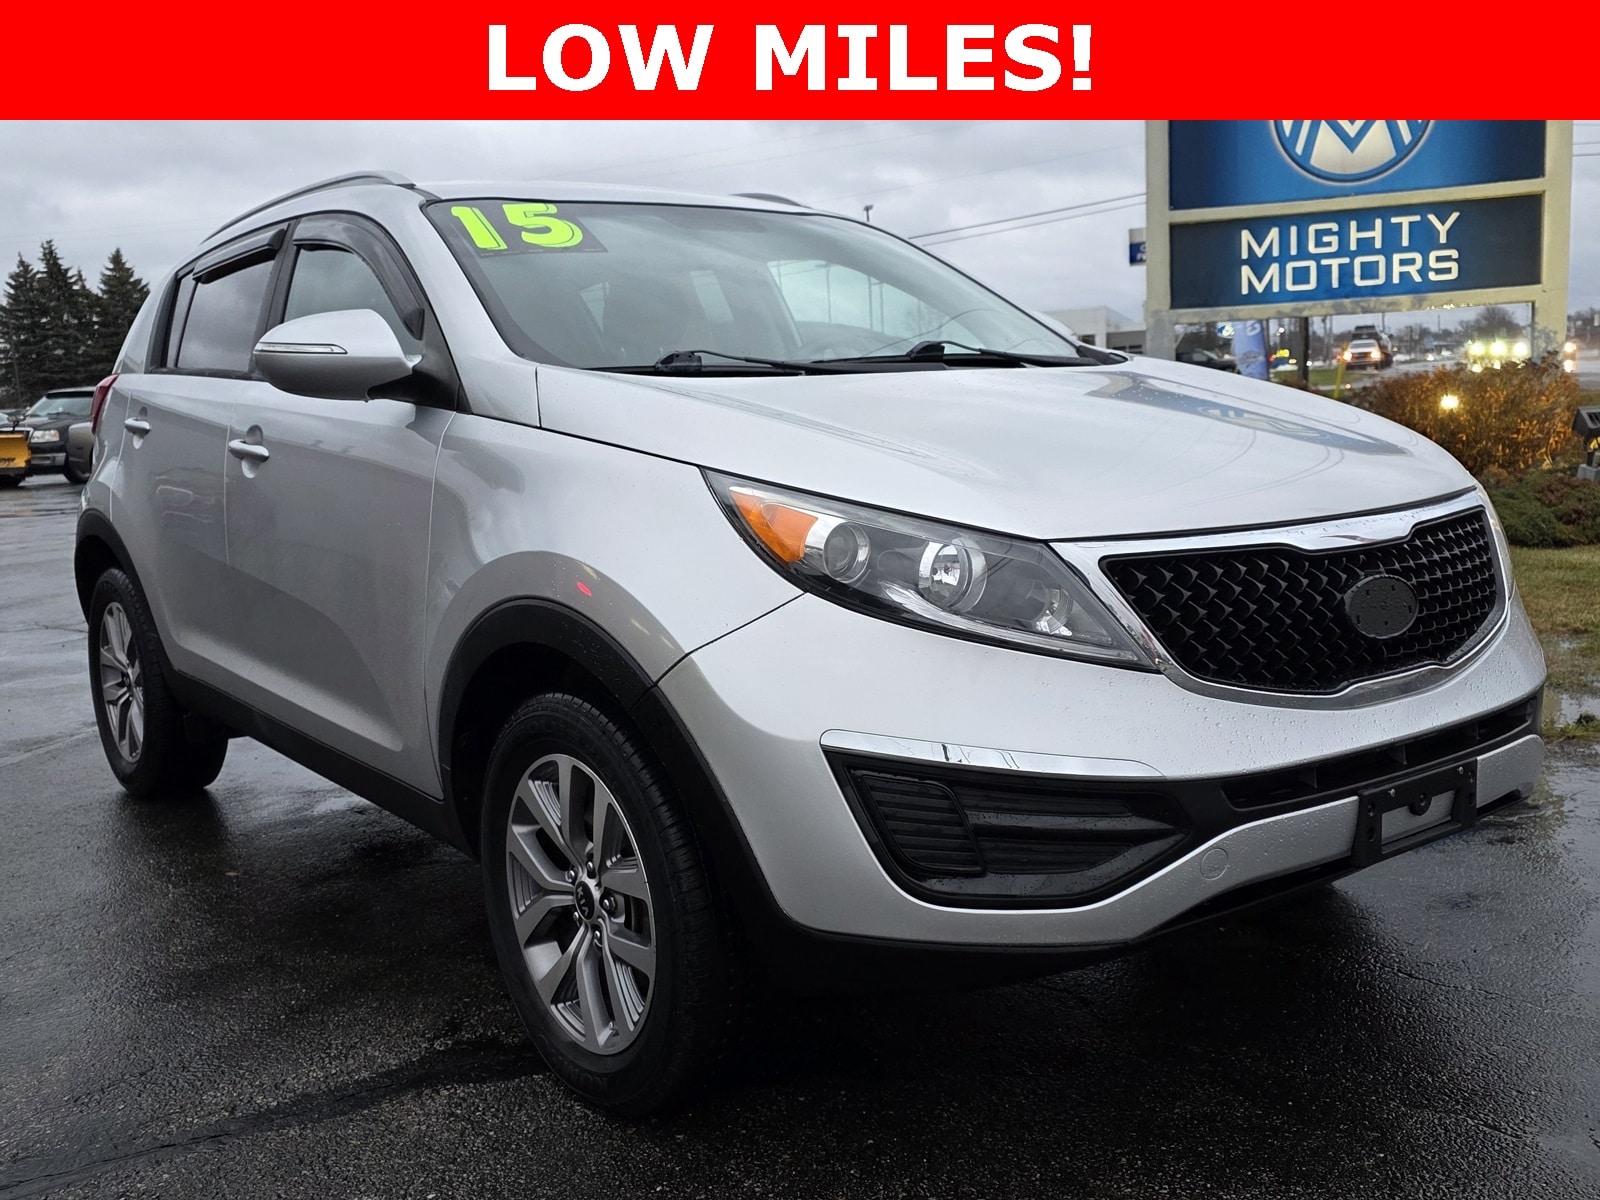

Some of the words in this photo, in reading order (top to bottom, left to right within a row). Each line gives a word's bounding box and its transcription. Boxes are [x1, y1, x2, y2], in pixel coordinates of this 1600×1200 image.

[450, 202, 584, 250] 15
[1240, 211, 1461, 260] MIGHTY
[1240, 248, 1460, 296] MOTORS
